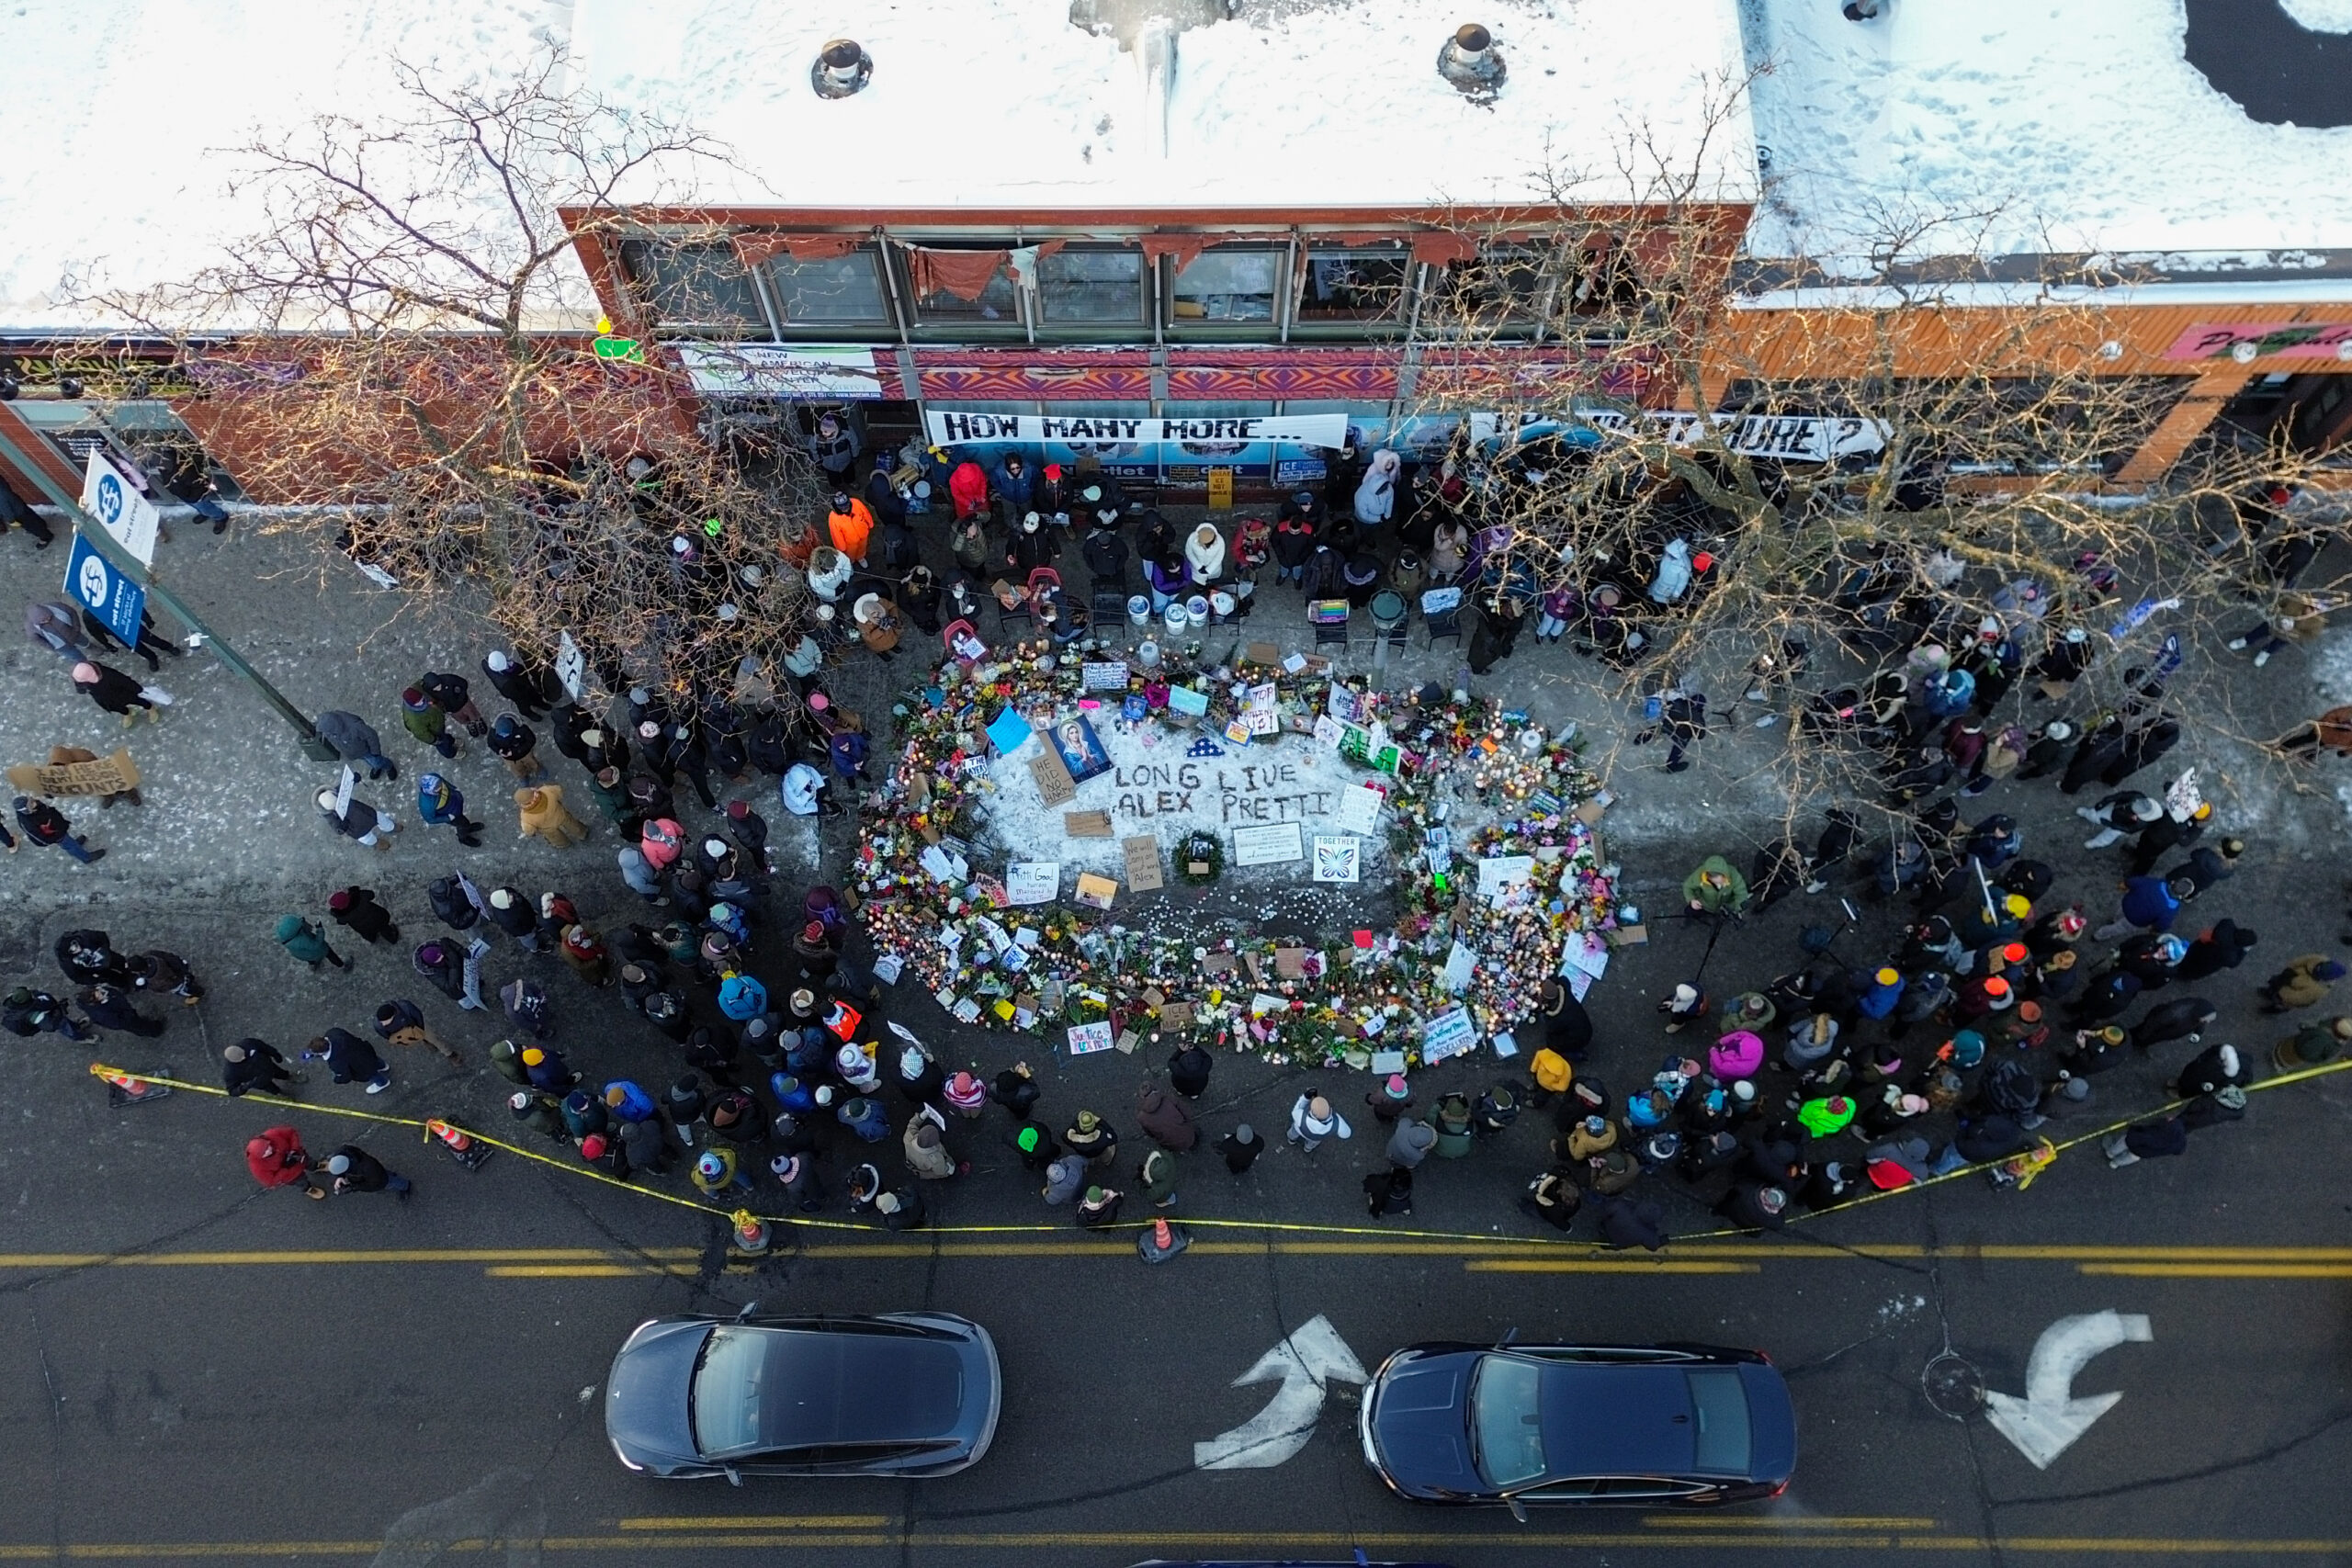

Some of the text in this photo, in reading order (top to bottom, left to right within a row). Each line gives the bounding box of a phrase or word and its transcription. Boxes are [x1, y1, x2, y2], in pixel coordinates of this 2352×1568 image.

[944, 413, 1303, 441] HOW MANY MORE...
[1060, 466, 1146, 476] Nllet
[1279, 461, 1297, 471] ICE
[112, 579, 126, 626] eat street
[1339, 739, 1396, 773] PRETI
[73, 761, 116, 773] HERE
[1035, 758, 1052, 772] HE
[1035, 769, 1059, 785] DID
[1115, 763, 1297, 793] LONG LIVE
[1046, 778, 1062, 792] NO
[1044, 787, 1071, 803] HARM
[1118, 791, 1193, 818] ALEX
[1222, 792, 1332, 824] PRETTI
[1125, 840, 1152, 855] We will
[1318, 837, 1355, 846] TOGETHER
[1035, 867, 1054, 881] Good
[1135, 872, 1155, 885] Alex
[1168, 1005, 1185, 1015] ICE
